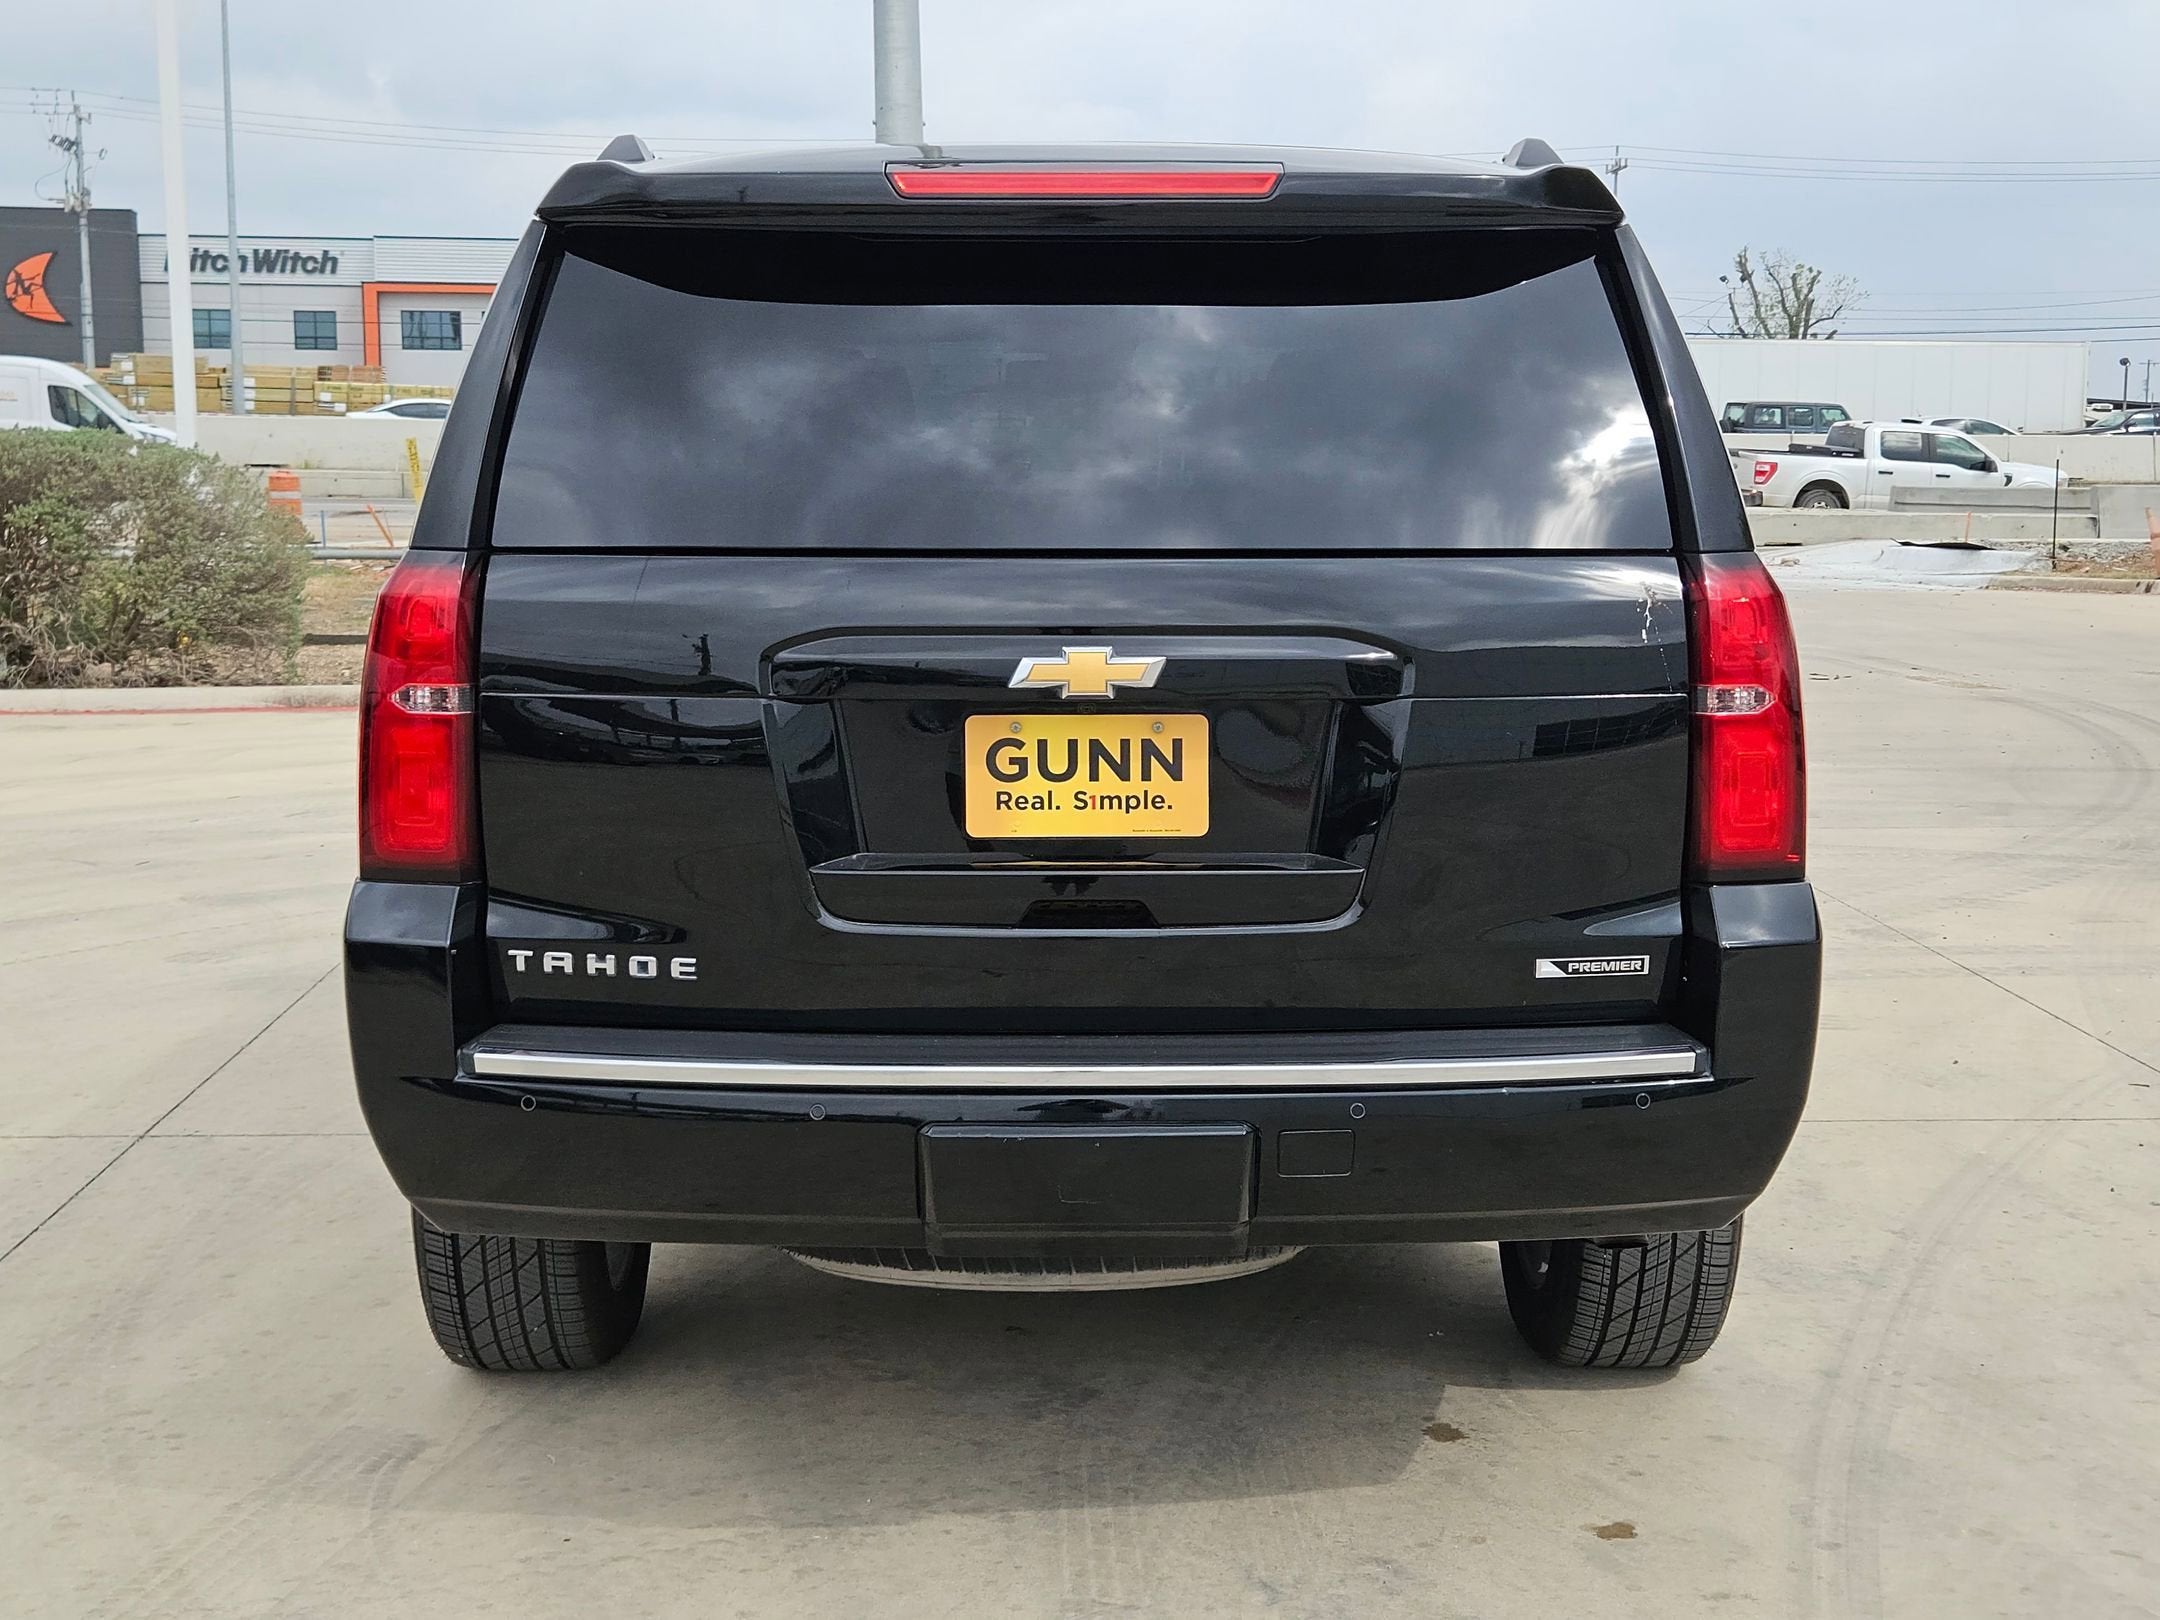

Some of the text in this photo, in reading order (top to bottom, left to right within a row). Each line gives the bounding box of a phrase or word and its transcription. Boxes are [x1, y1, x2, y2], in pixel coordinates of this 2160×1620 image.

[163, 247, 339, 275] itch Witch
[985, 737, 1183, 783] GUNN
[995, 789, 1173, 814] Real. S1mple.
[507, 949, 698, 981] TAHOE
[1567, 960, 1643, 974] PREMIER
